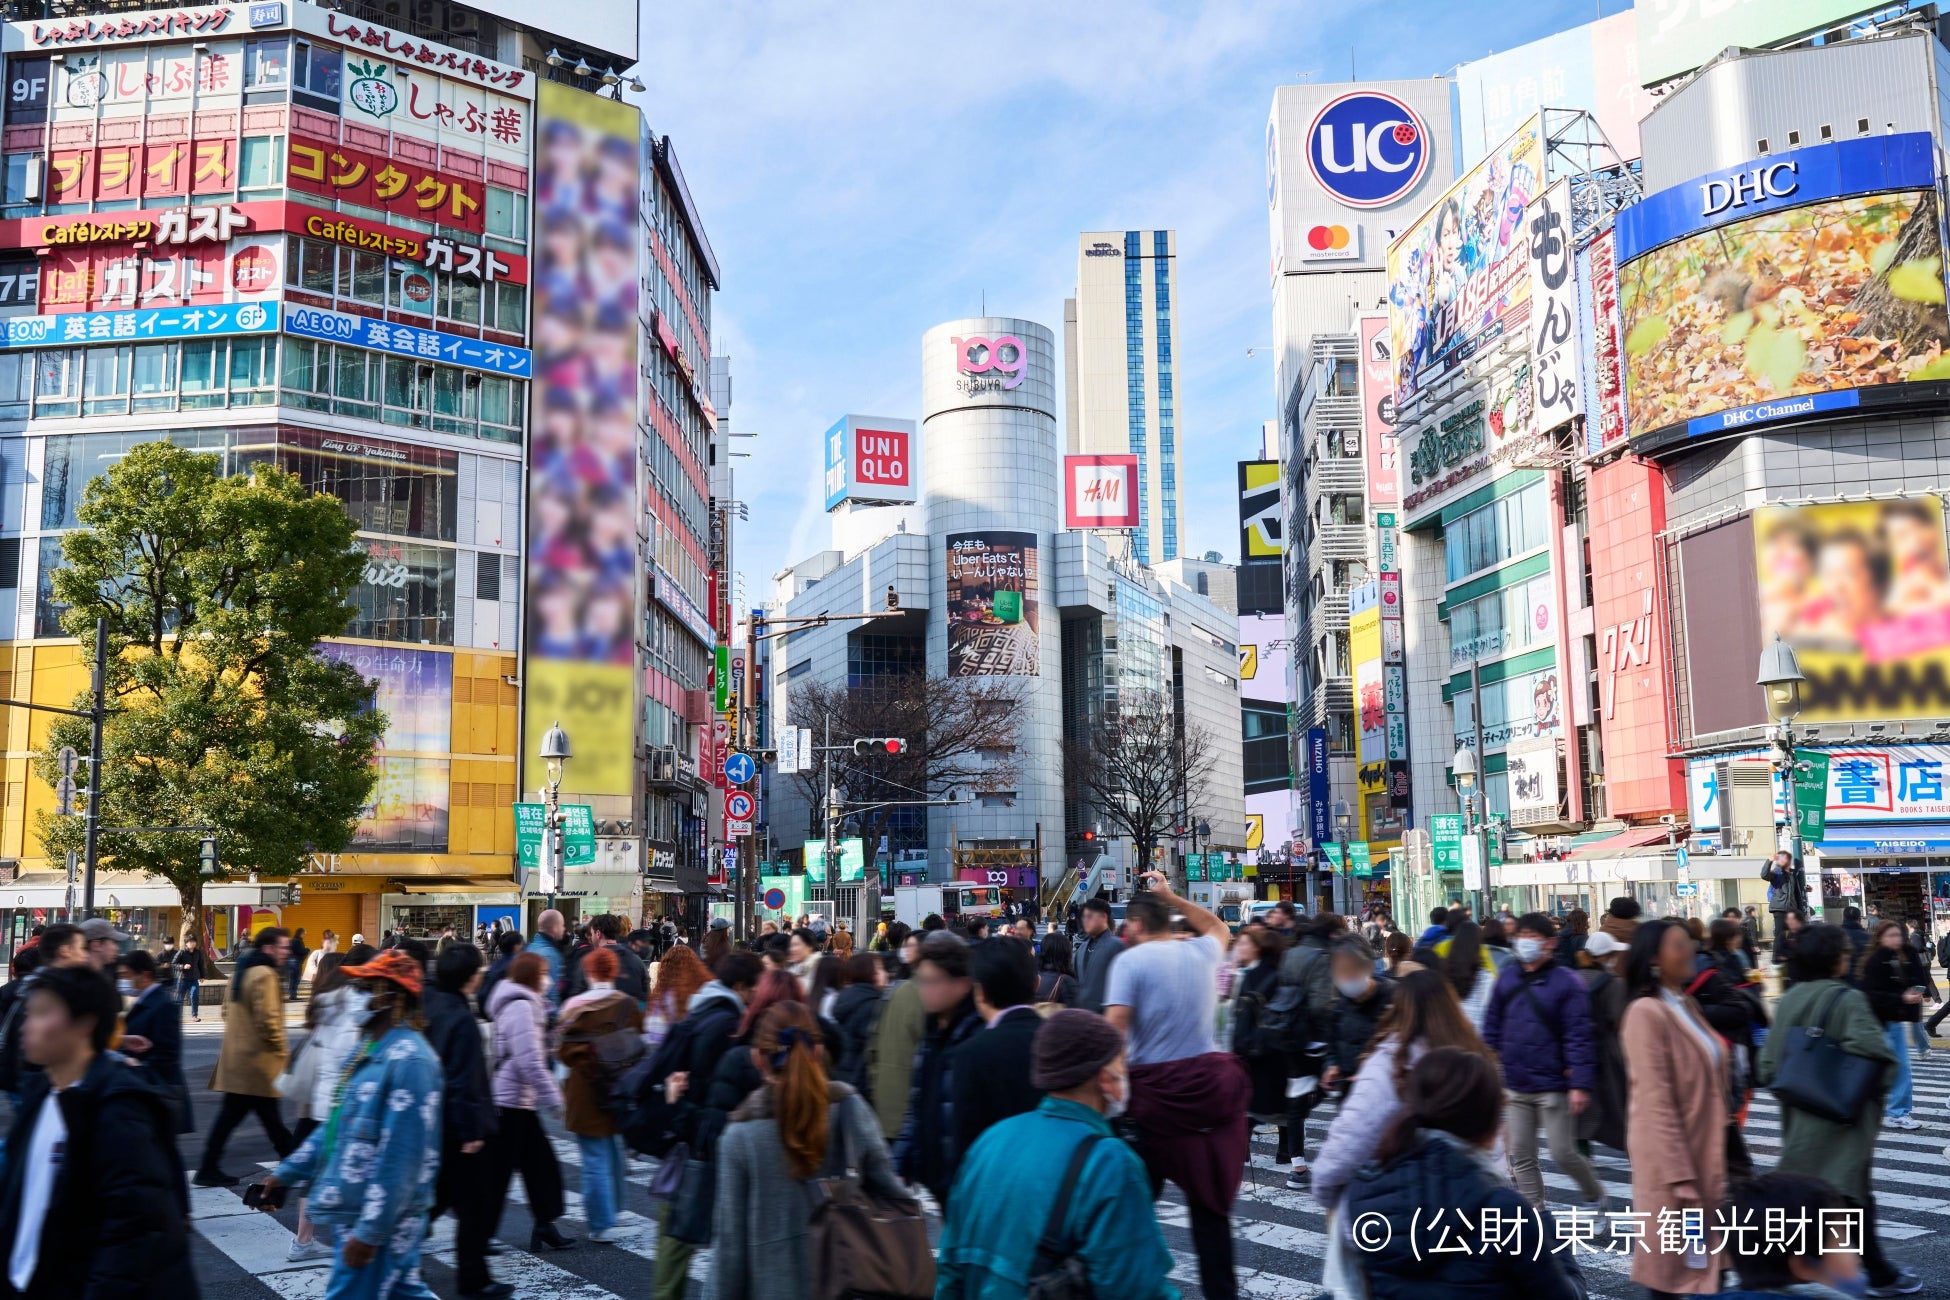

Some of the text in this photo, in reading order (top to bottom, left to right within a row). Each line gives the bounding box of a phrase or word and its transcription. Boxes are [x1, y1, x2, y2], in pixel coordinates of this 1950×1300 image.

[32, 7, 231, 45] しゃぶしゃぶバイキング
[251, 6, 279, 23] 寿司
[328, 13, 526, 89] しゃぶしゃぶバイキング
[118, 53, 229, 97] しゃぶ葉
[12, 77, 46, 102] 9F
[409, 82, 521, 144] しゃぶ葉
[1321, 120, 1415, 174] UC
[52, 145, 230, 192] プライス
[290, 143, 479, 217] コンタクト
[1700, 161, 1799, 218] DHC
[156, 205, 247, 245] ガスト
[425, 238, 509, 282] ガスト
[1310, 250, 1350, 258] mastercard
[0, 275, 36, 301] 7F
[101, 257, 214, 308] ガスト
[1531, 198, 1576, 414] もんじゃ
[296, 311, 350, 336] AEON
[950, 336, 1027, 390] 109
[956, 379, 1001, 391] SHIBUYA
[1722, 398, 1815, 428] DHC Channel
[321, 439, 344, 452] King
[363, 445, 407, 460] Yakiniku
[861, 436, 899, 457] UNI
[861, 458, 903, 480] QLO
[1084, 478, 1120, 504] H&M
[953, 540, 991, 552] 今年も、
[953, 556, 979, 566] Uber
[1455, 724, 1532, 749] ジャスミディースクリニック
[1315, 737, 1323, 774] MIZUHO
[518, 806, 543, 820] 请在
[1316, 800, 1325, 839] みずほ銀行
[1900, 806, 1924, 814] BOOKS
[1435, 817, 1459, 830] 请在
[986, 871, 1008, 886] 109
